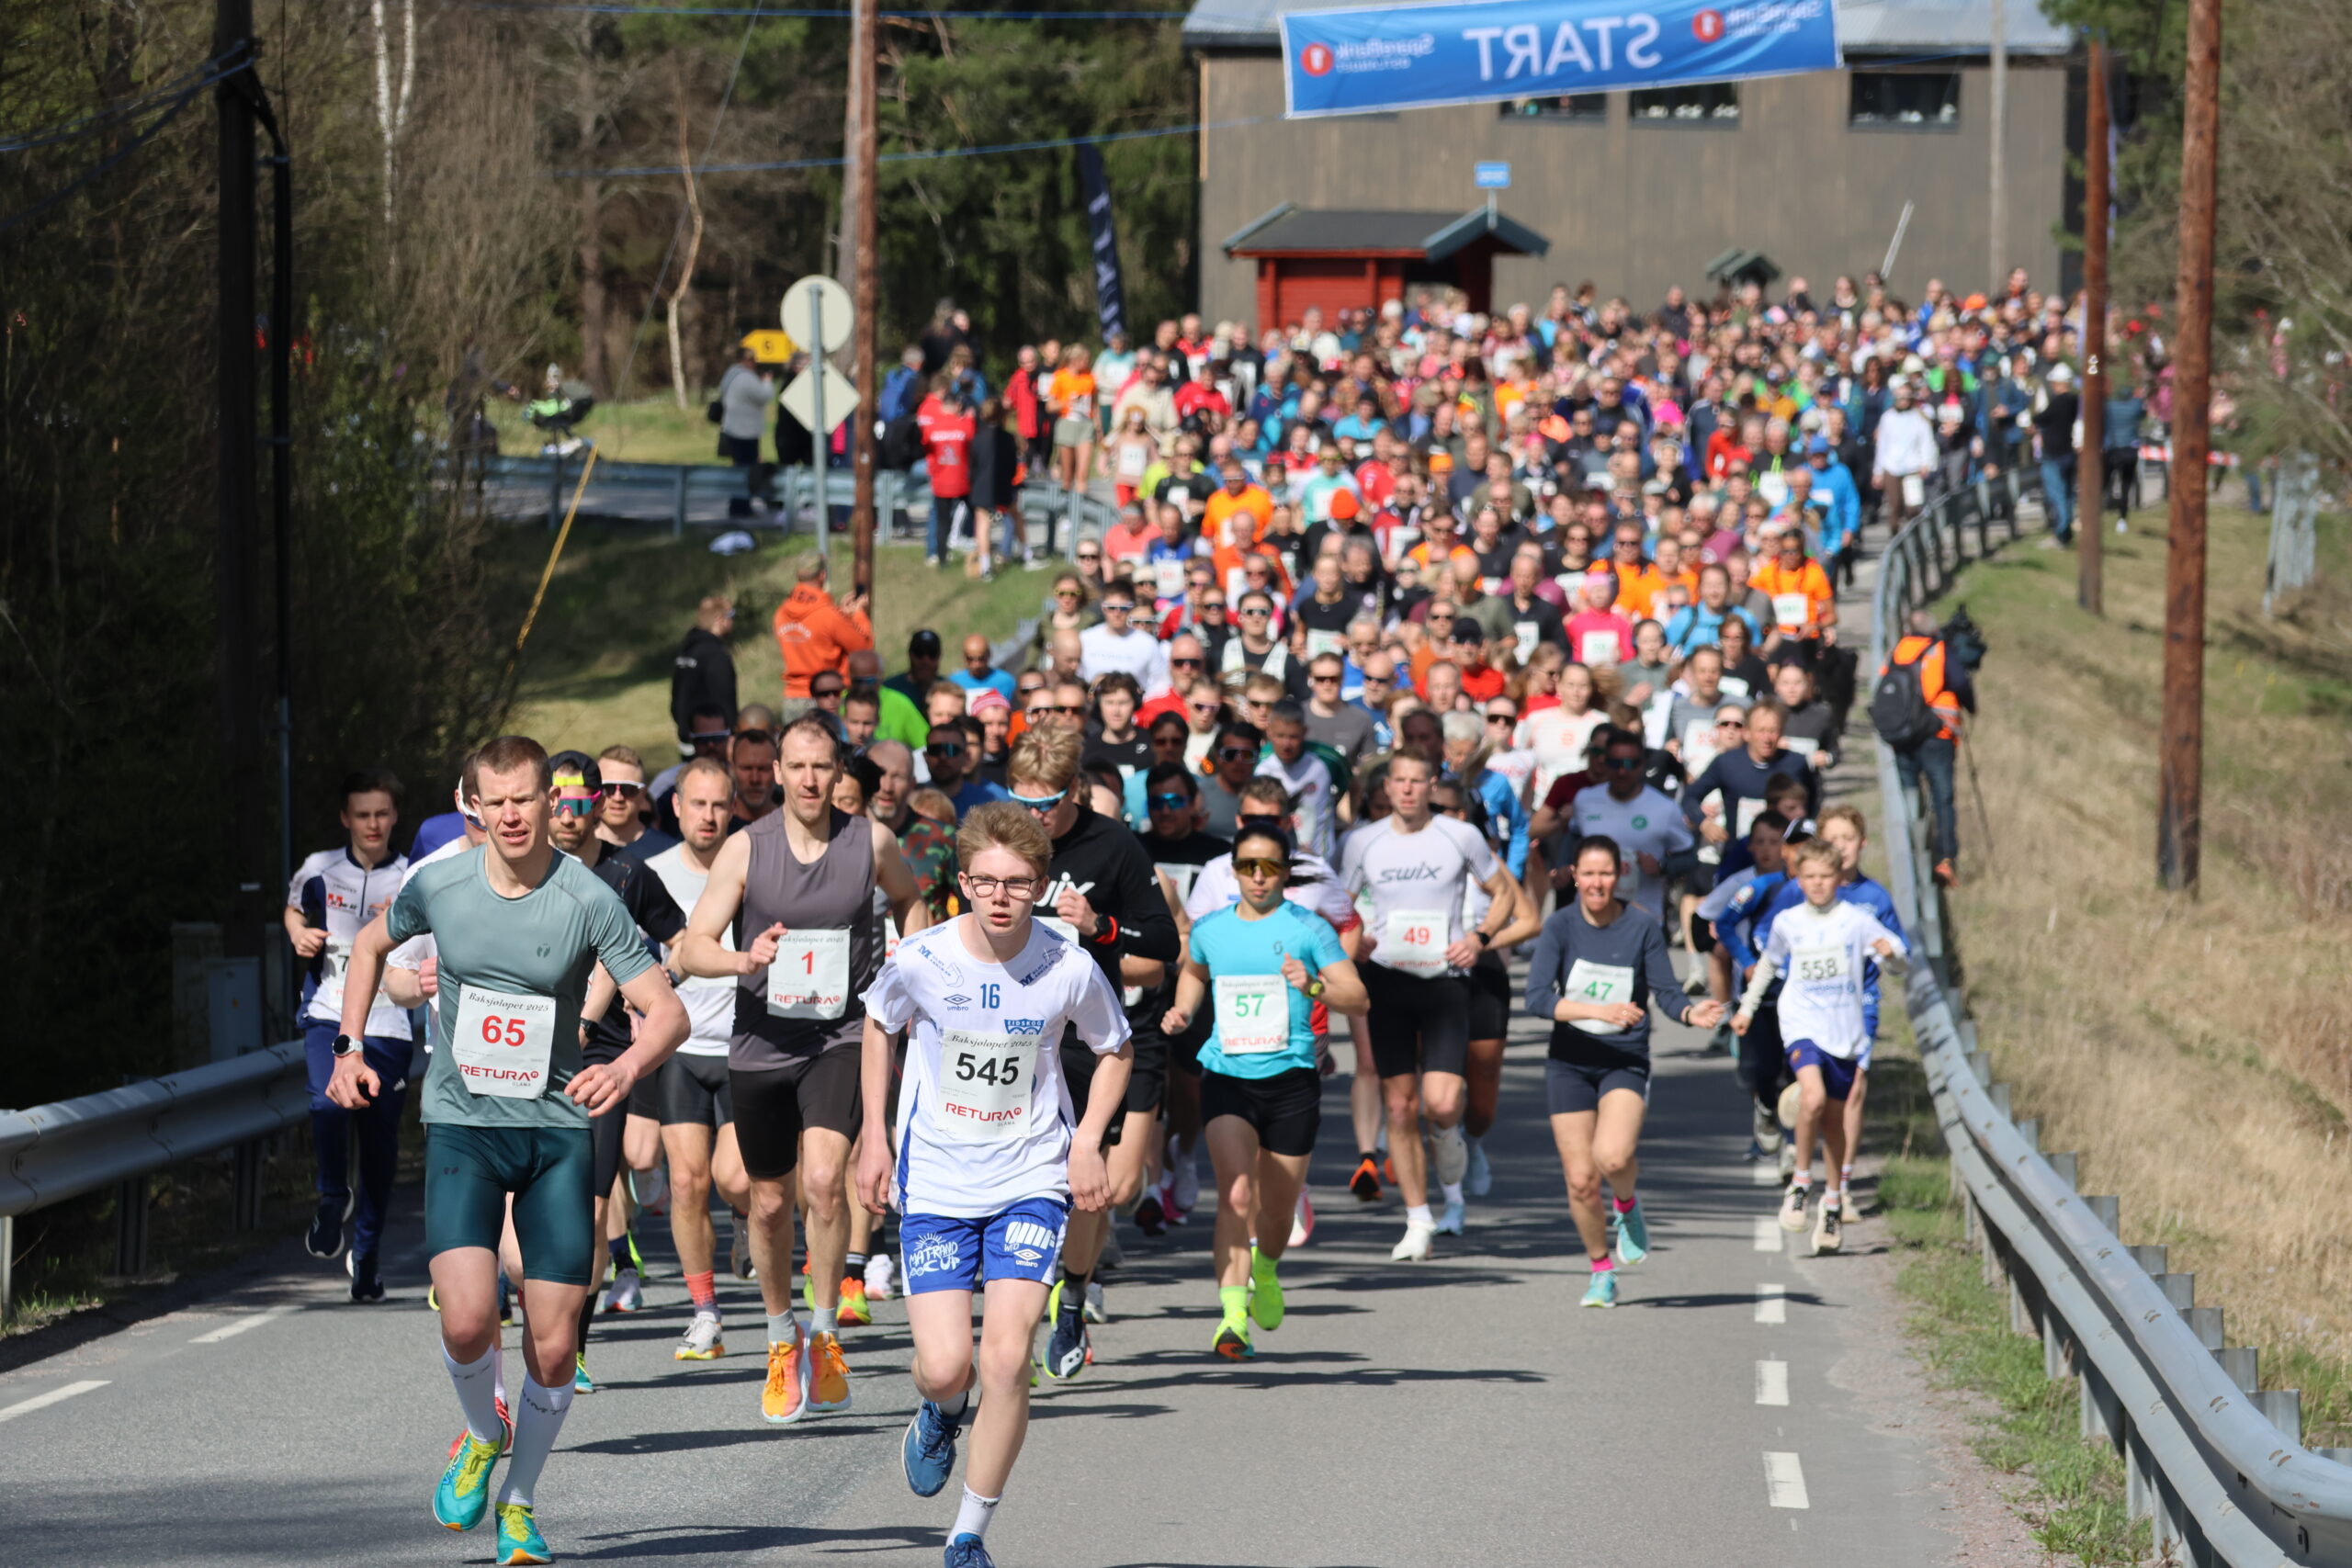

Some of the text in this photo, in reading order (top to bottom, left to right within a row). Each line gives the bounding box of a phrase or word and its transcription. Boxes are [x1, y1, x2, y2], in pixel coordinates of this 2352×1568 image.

[1402, 925, 1430, 946] 49
[801, 950, 813, 975] 1
[1801, 958, 1838, 981] 558
[774, 993, 833, 1006] RETURA
[979, 983, 1001, 1010] 16
[1583, 980, 1613, 1000] 47
[526, 1004, 549, 1012] 2025
[1235, 994, 1265, 1017] 57
[481, 1015, 526, 1047] 65
[1010, 1040, 1033, 1048] 2025
[459, 1063, 531, 1082] RETURA
[956, 1052, 1020, 1087] 545
[945, 1102, 1014, 1122] RETURA
[1015, 1259, 1039, 1268] umbro
